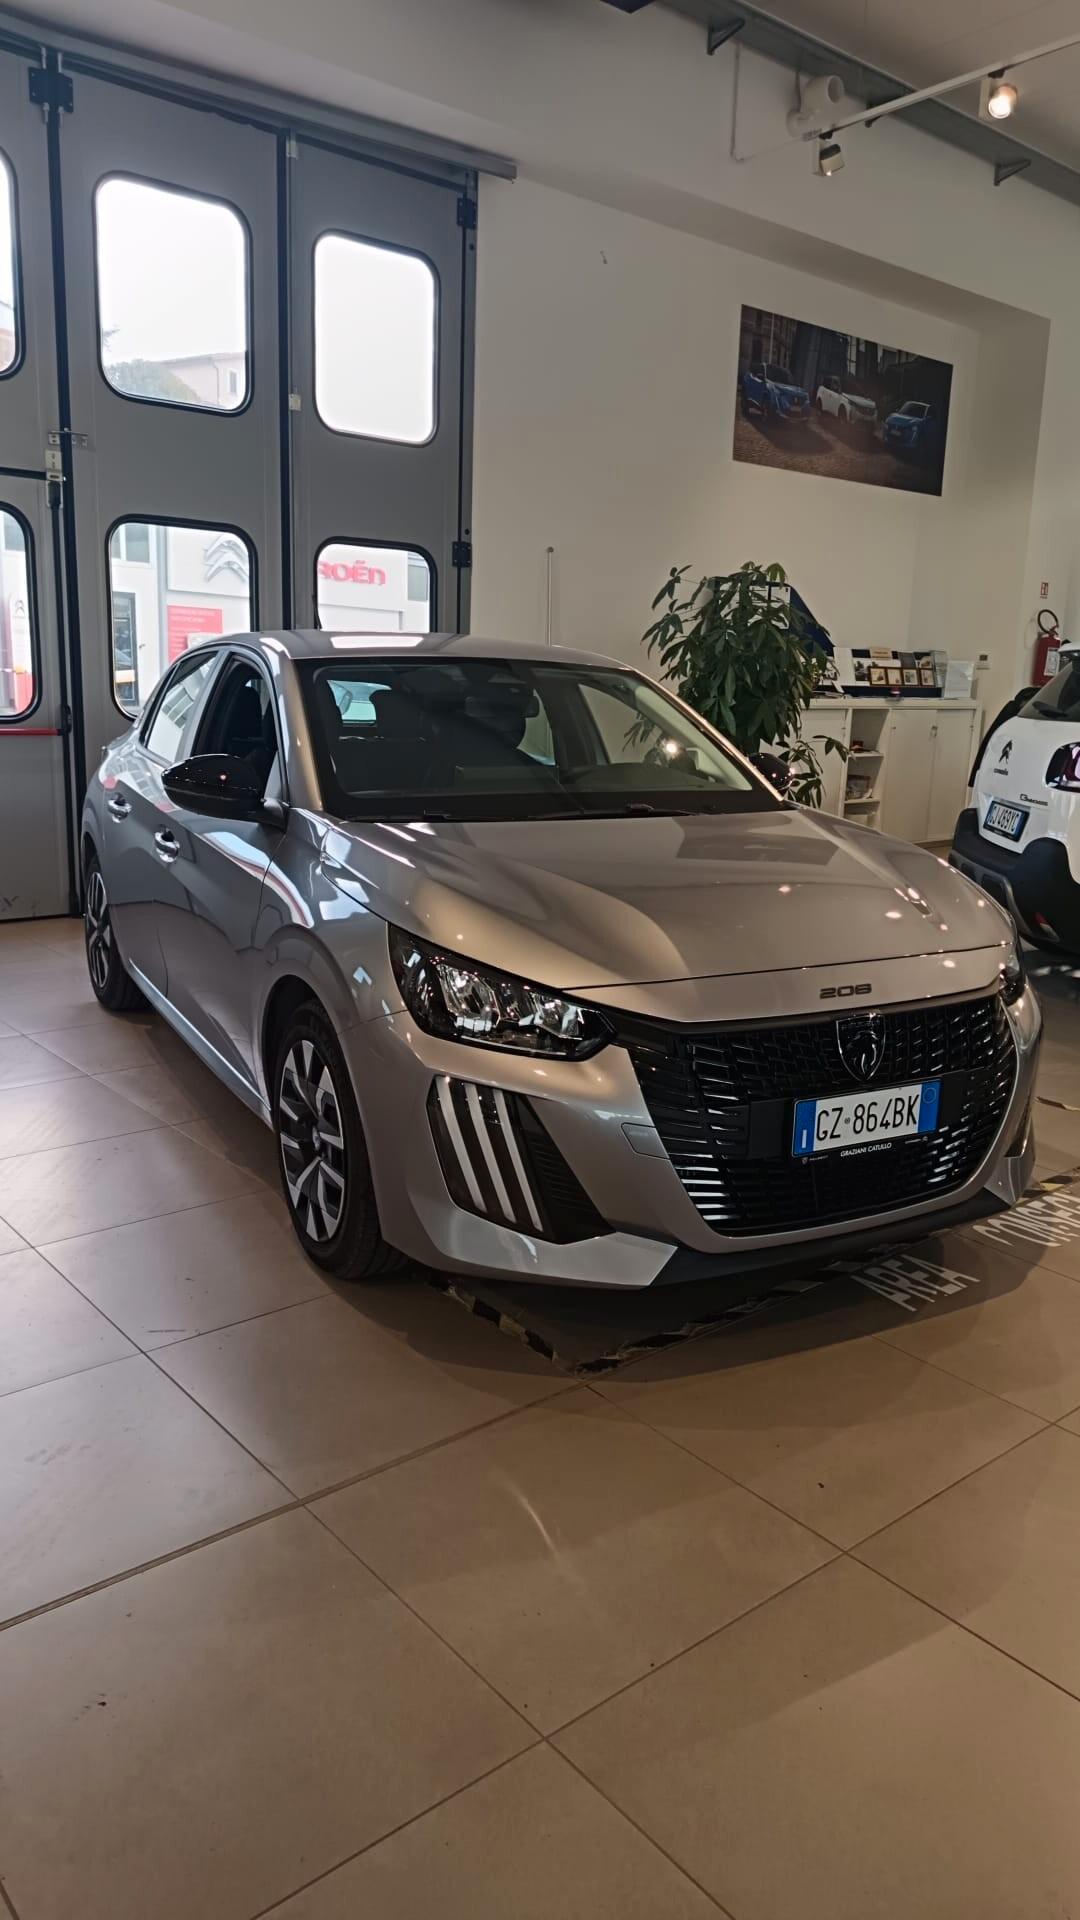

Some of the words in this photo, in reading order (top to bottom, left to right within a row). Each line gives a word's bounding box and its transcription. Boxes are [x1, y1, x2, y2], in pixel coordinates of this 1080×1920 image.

[820, 983, 872, 999] 208
[840, 1147, 868, 1157] GRAZIANI
[868, 1142, 892, 1153] CATULLO
[850, 1253, 981, 1312] AREA
